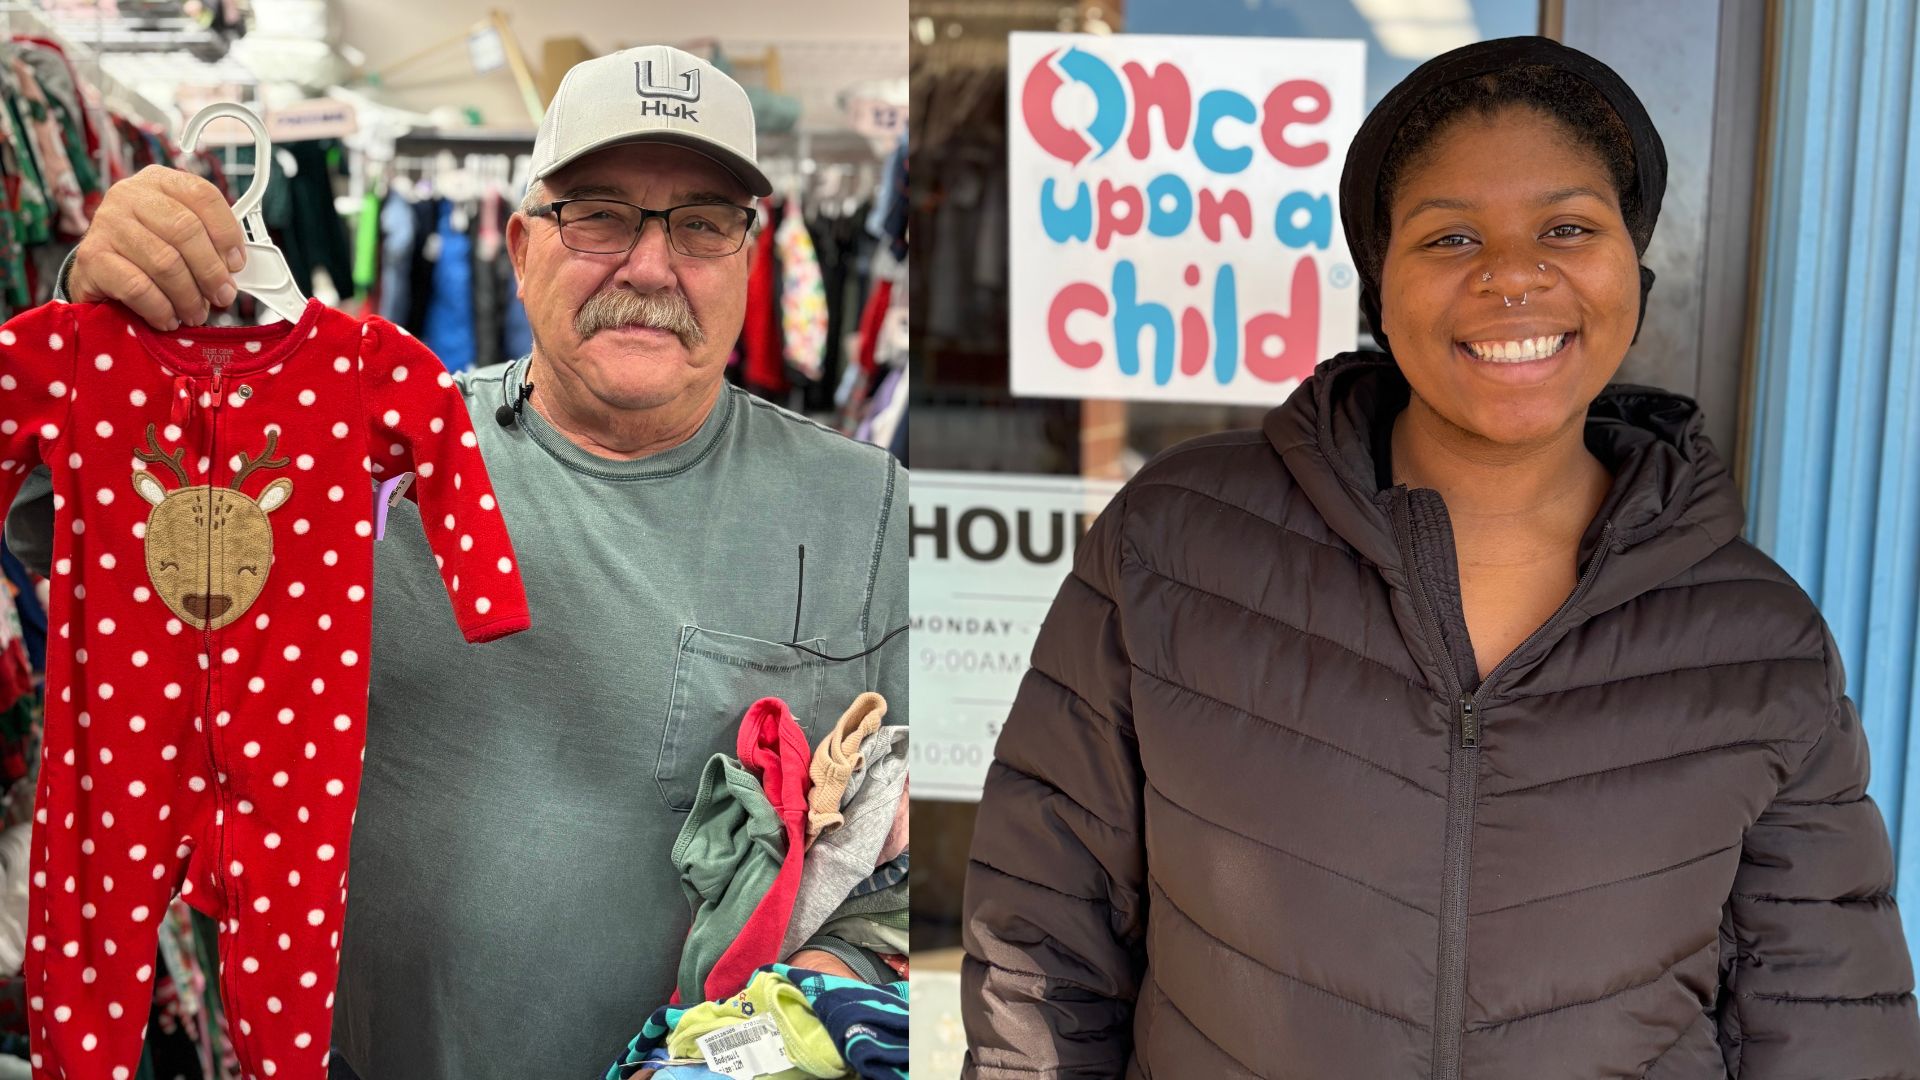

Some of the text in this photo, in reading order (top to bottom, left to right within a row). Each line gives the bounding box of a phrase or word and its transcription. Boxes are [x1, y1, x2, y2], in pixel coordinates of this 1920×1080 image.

[641, 100, 699, 123] Huk
[1021, 44, 1333, 174] Once
[1040, 173, 1333, 251] upon a
[1047, 254, 1321, 387] child
[909, 504, 1087, 564] HOU
[909, 615, 1013, 635] MONDAY
[920, 647, 1021, 673] 9:00AM
[912, 741, 983, 768] 10:00
[719, 1060, 744, 1073] ize:12M
